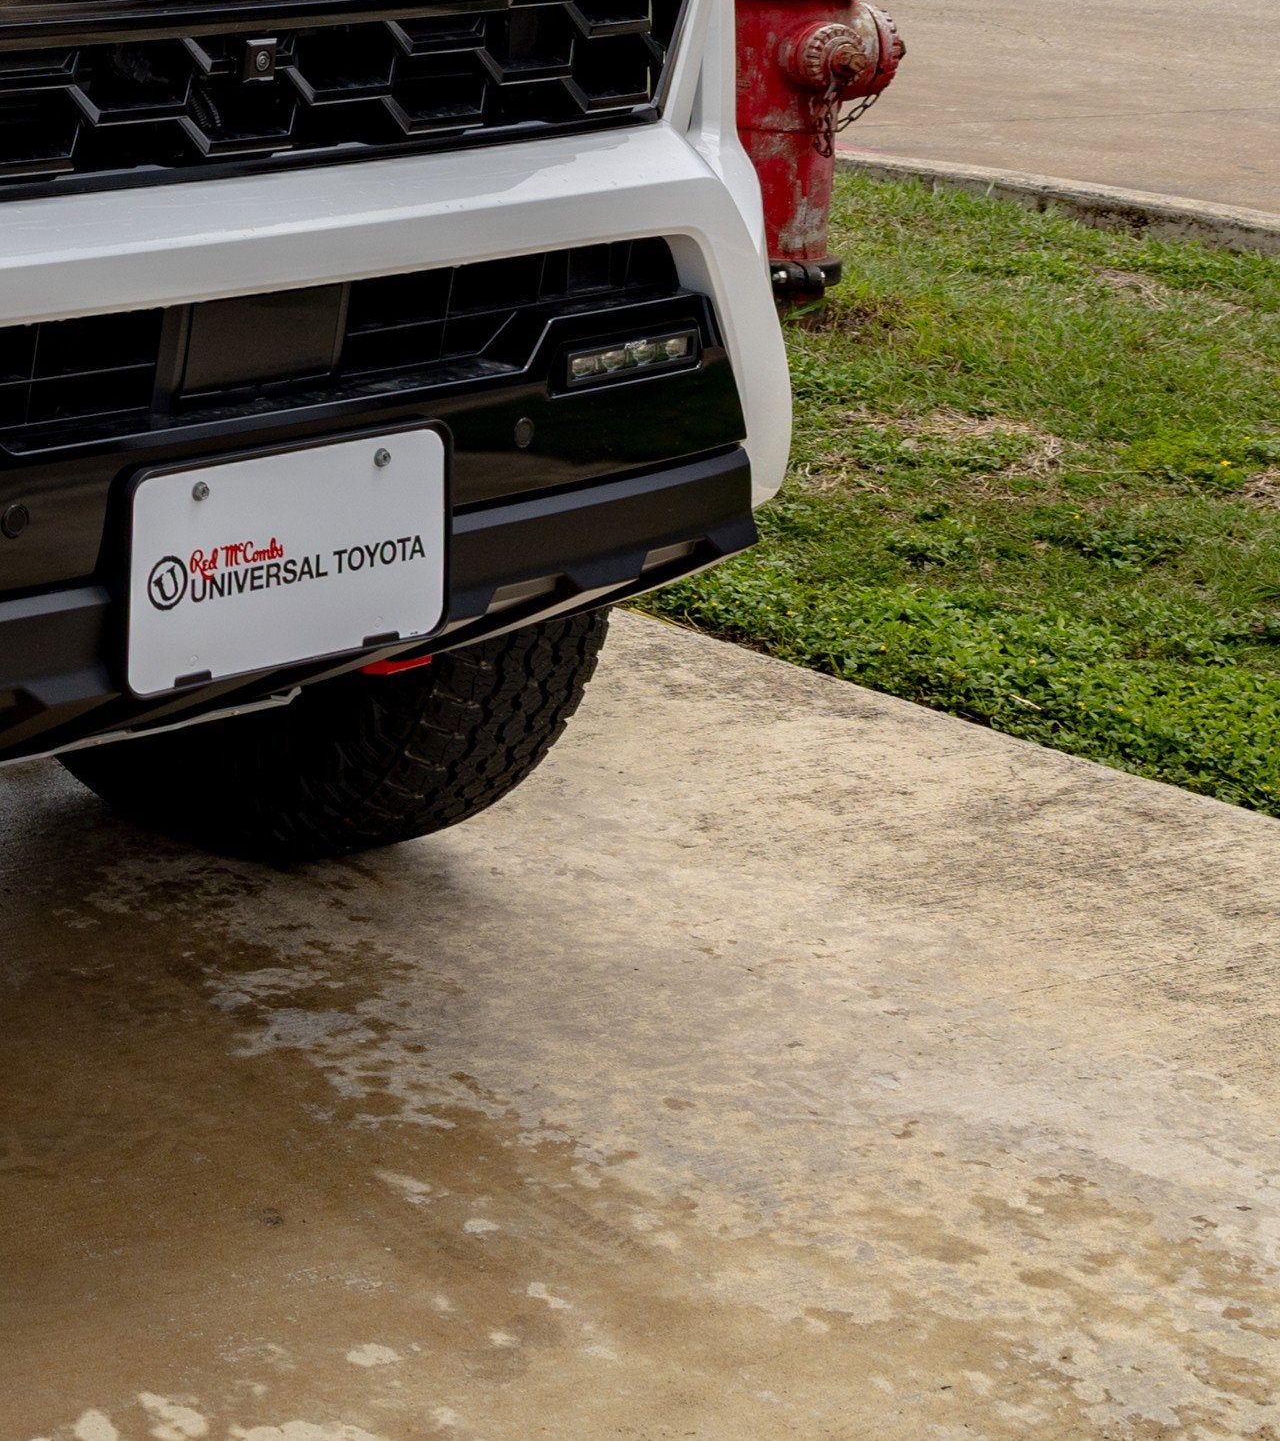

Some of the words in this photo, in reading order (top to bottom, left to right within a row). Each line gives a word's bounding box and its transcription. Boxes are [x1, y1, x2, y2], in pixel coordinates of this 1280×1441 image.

[190, 549, 218, 581] Red
[190, 554, 328, 603] UNIVERSAL
[333, 534, 426, 574] TOYOTA
